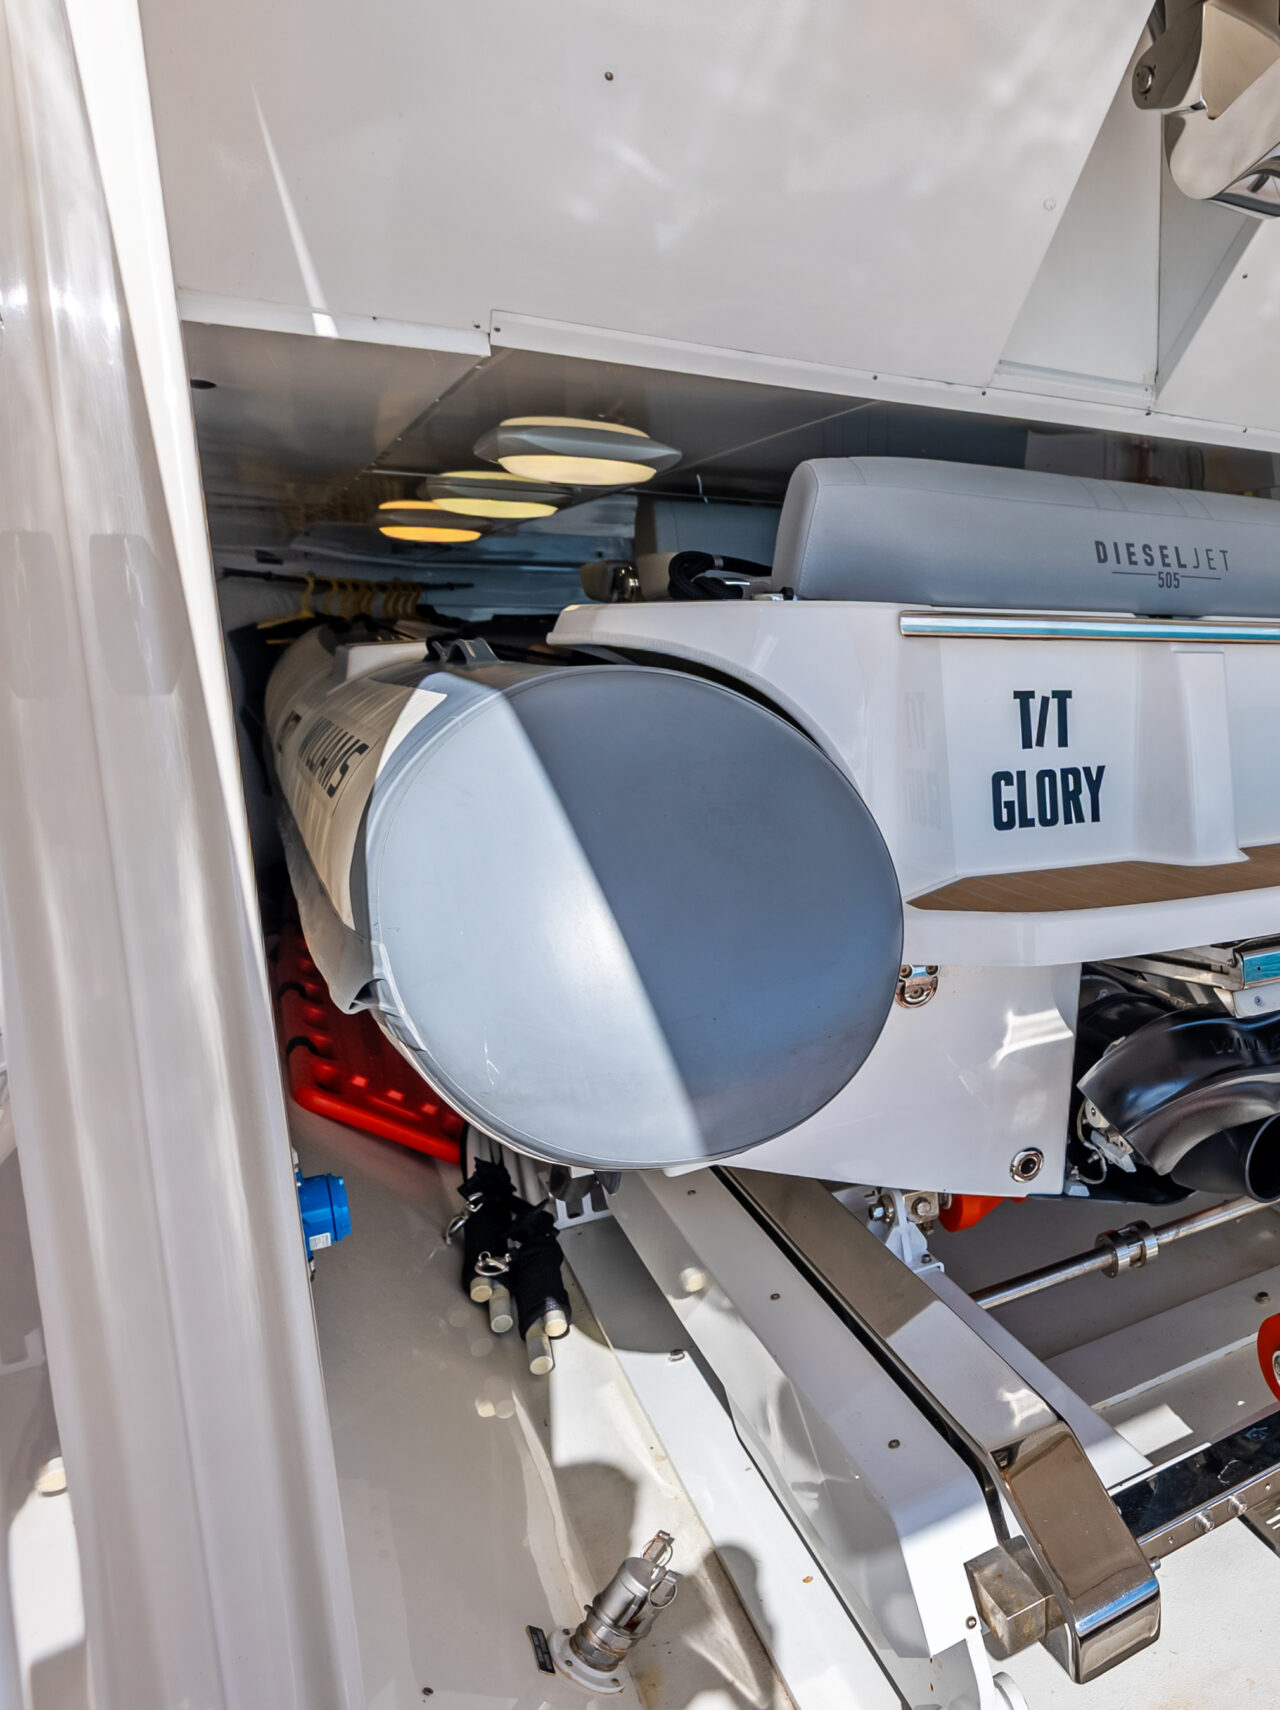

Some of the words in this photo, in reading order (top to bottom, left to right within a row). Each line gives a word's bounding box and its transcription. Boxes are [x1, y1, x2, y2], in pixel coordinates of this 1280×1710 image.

[1157, 571, 1181, 589] 505
[1013, 690, 1073, 750] T/T
[992, 765, 1106, 831] GLORY
